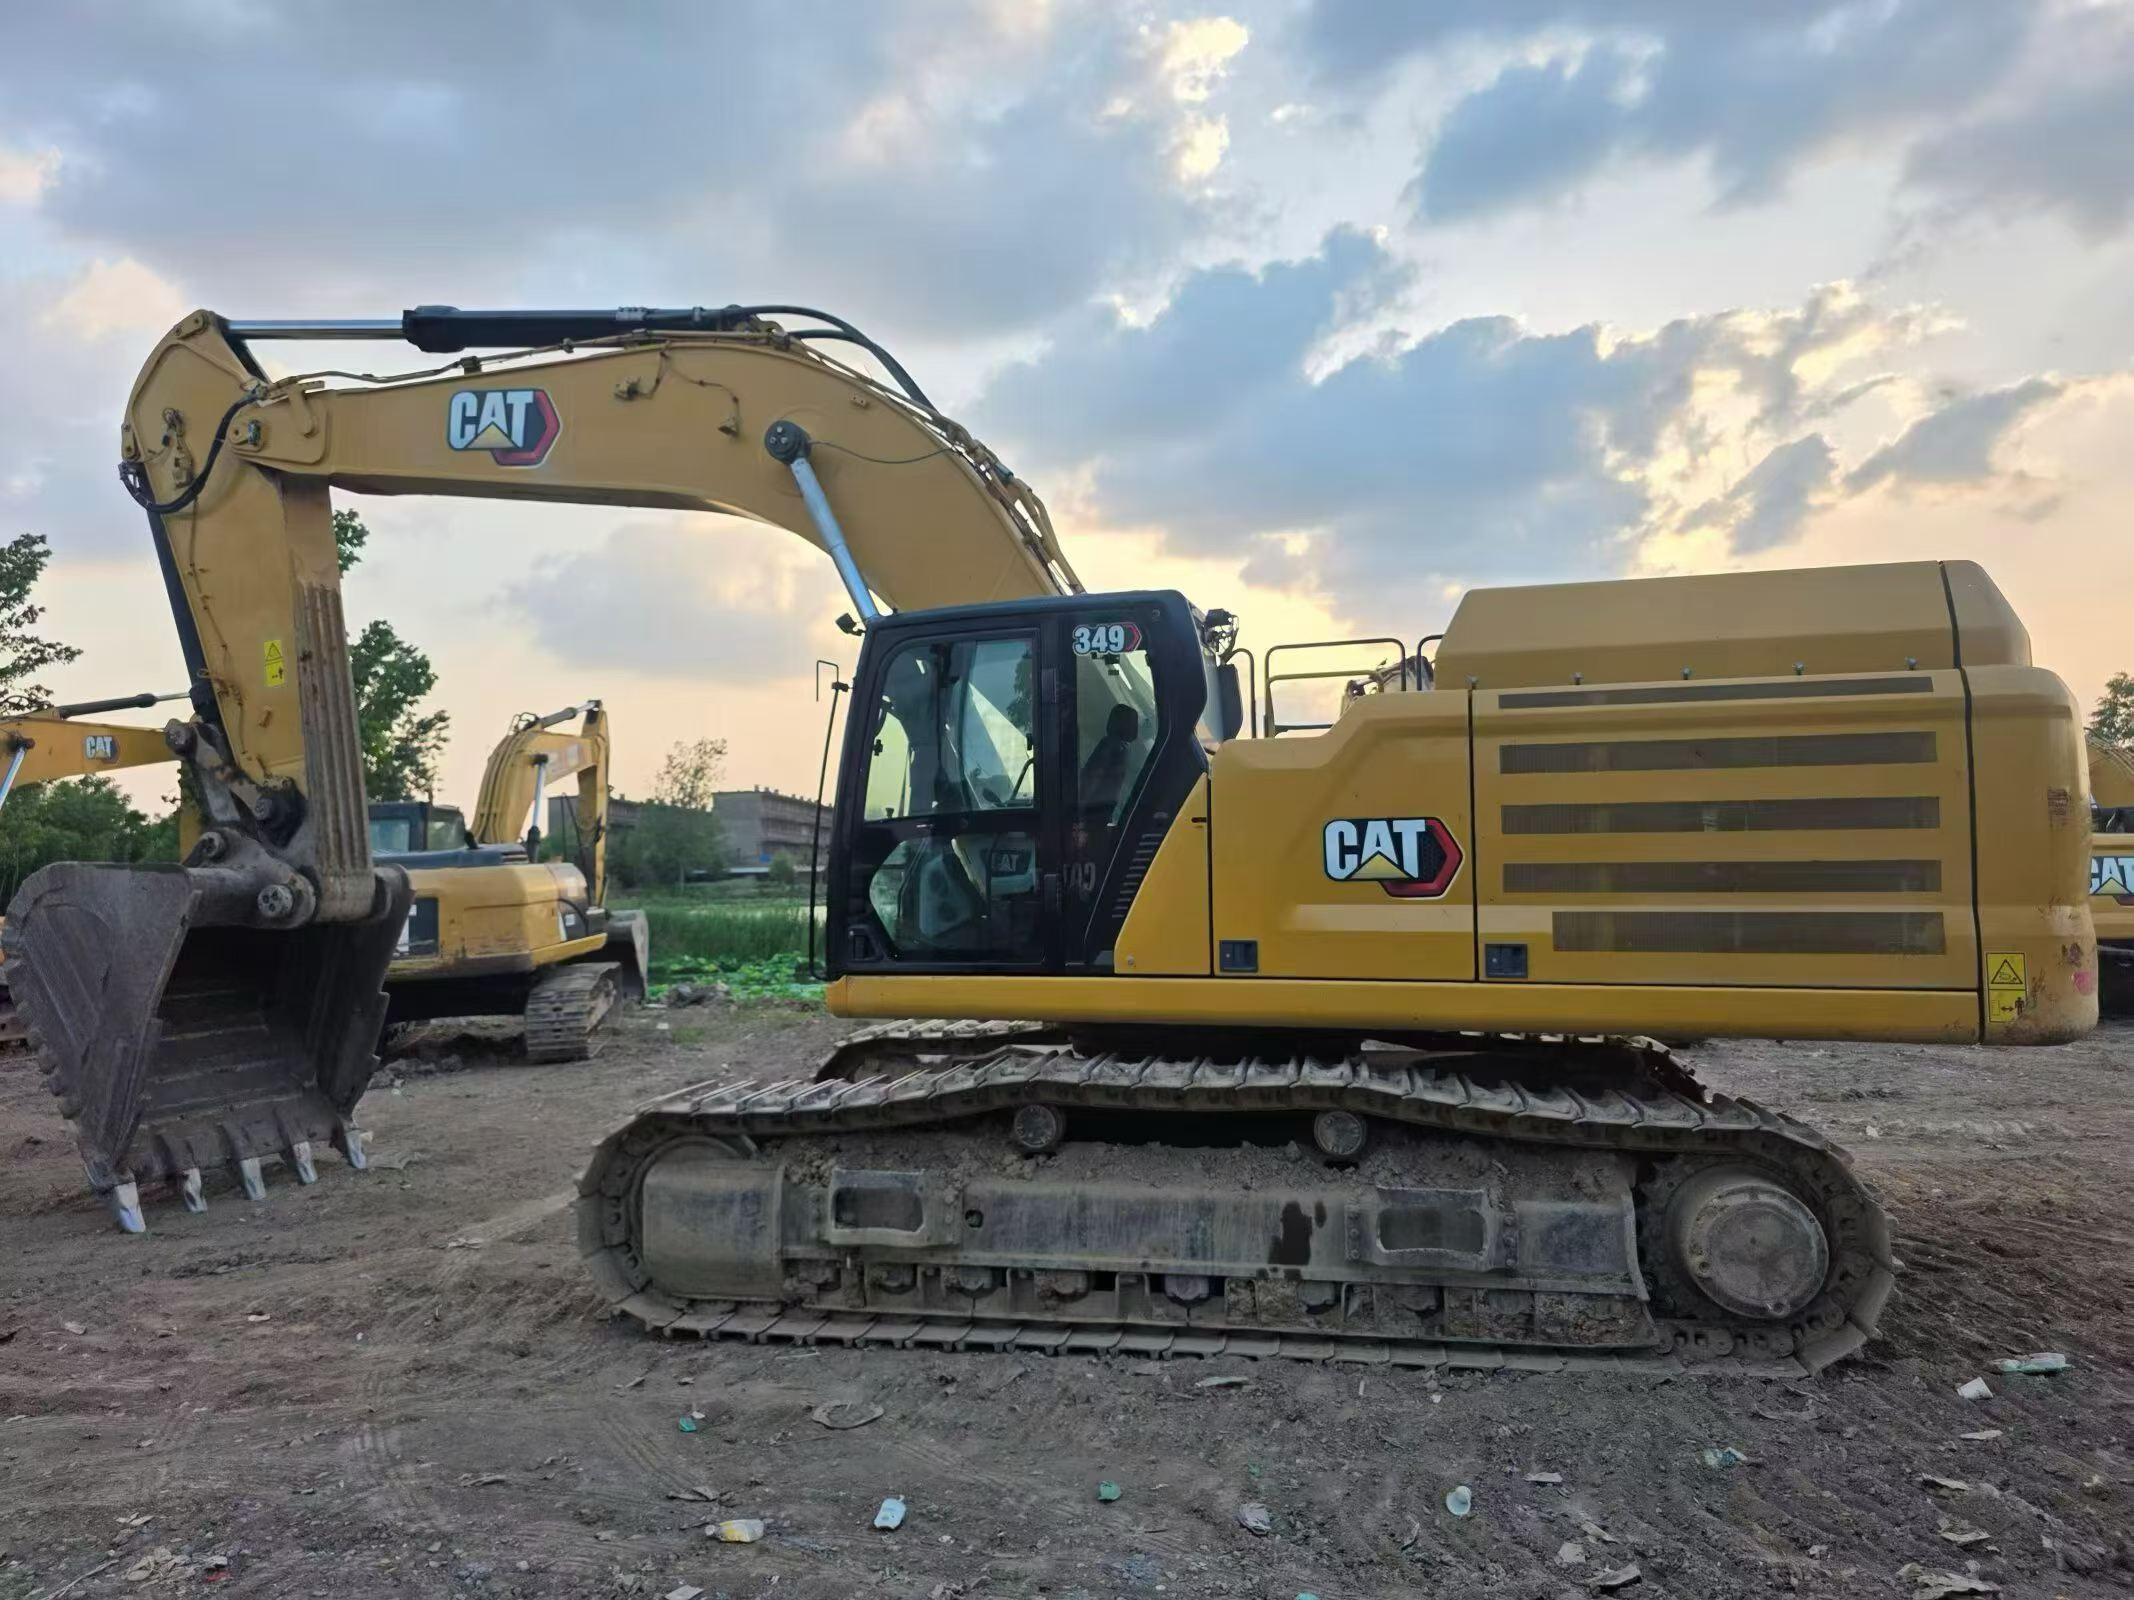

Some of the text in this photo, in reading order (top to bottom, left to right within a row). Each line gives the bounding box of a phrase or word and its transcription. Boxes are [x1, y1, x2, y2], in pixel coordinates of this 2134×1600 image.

[449, 389, 534, 449] CAT
[1075, 625, 1125, 654] 349
[86, 736, 113, 758] CAT
[1325, 819, 1426, 880] CAT
